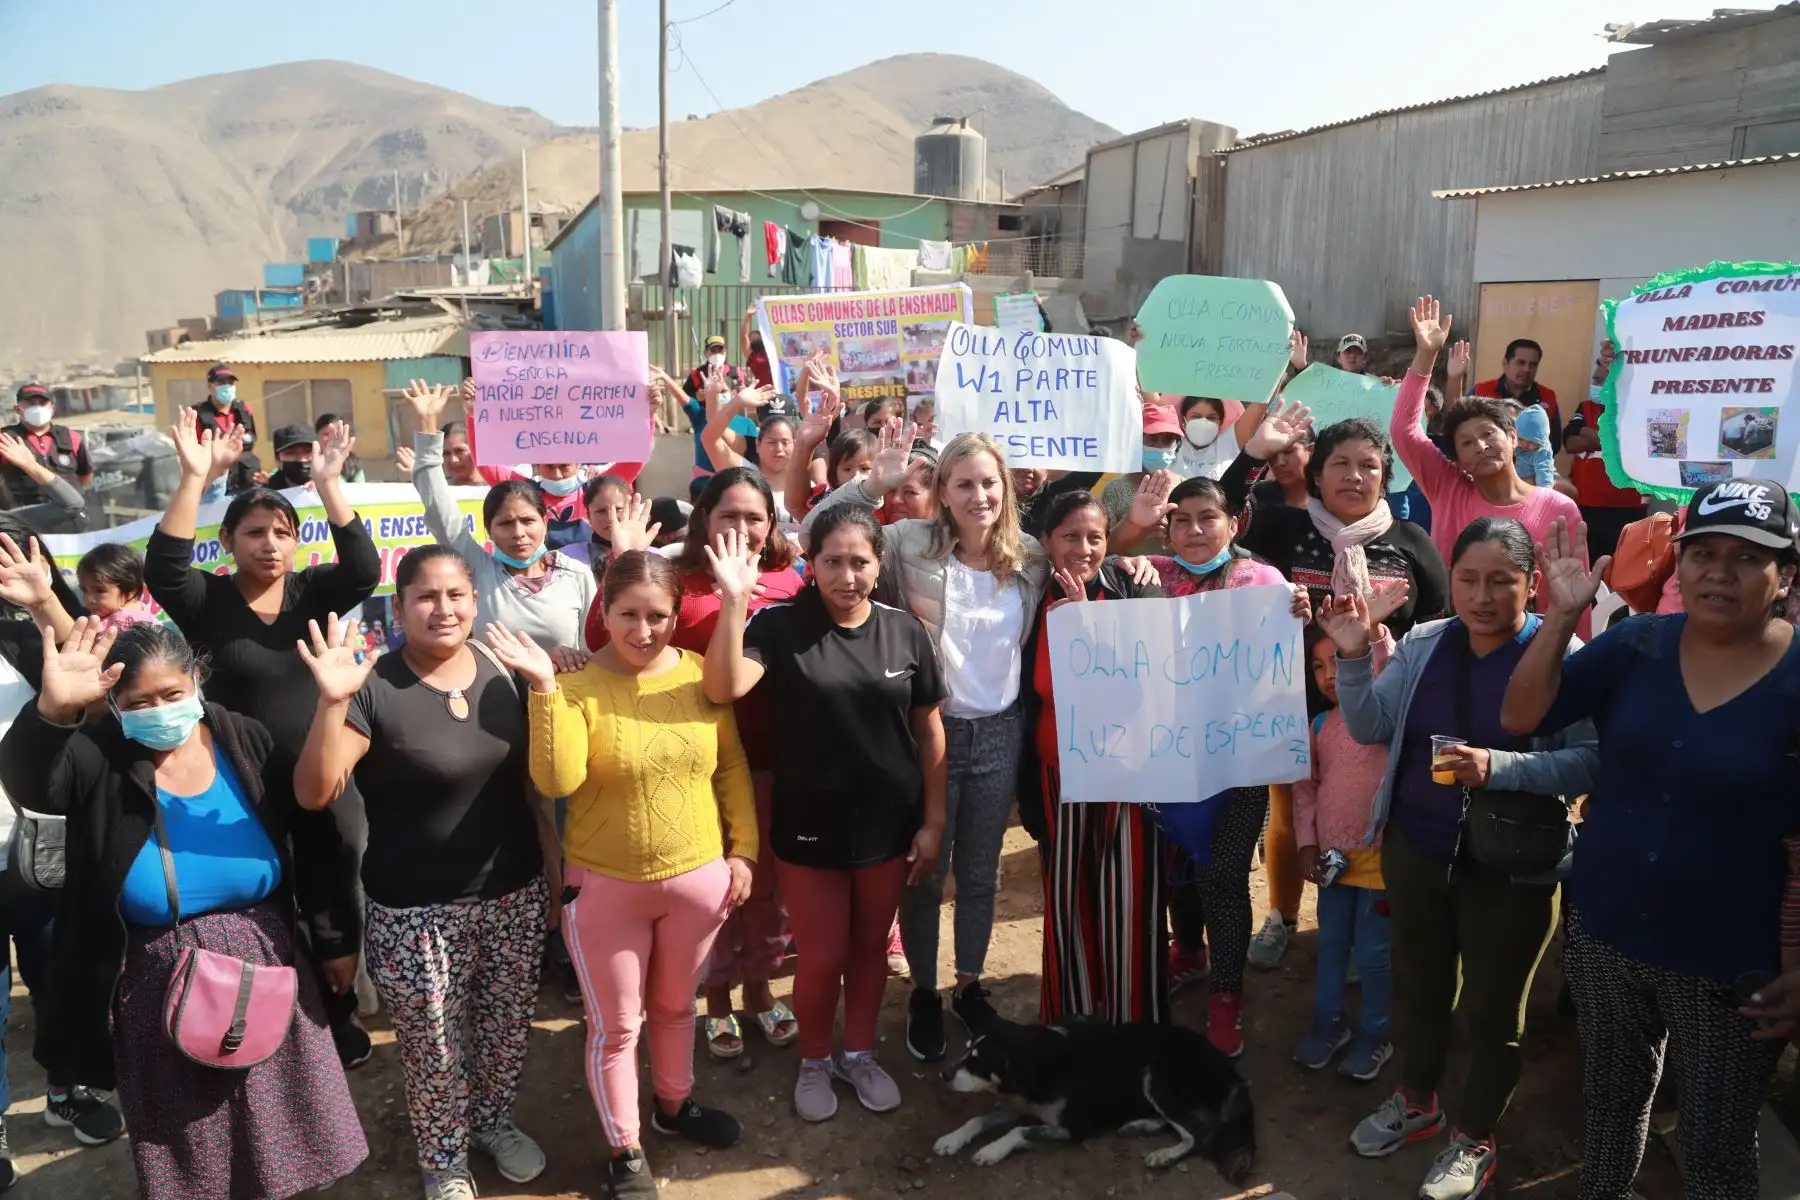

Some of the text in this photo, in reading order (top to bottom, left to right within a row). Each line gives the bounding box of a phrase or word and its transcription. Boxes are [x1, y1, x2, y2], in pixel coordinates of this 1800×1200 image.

[1635, 284, 1692, 303] OLLA
[771, 292, 958, 325] OLLAS COMUNES DE LA ENSENADA
[1168, 296, 1210, 321] OLLA
[834, 320, 898, 338] SECTOR SUR
[1662, 310, 1765, 332] MADRES
[951, 326, 1007, 356] OLLA
[1160, 331, 1290, 355] NUEVA FORTALEZ
[1621, 344, 1795, 365] RIUNFADORAS
[503, 366, 568, 382] SEÑORA
[1016, 368, 1097, 392] PARTE
[568, 384, 636, 400] CARMEN
[844, 384, 905, 399] RESENTE
[1650, 378, 1775, 395] PRESENTE
[478, 405, 624, 423] A NUESTRA ZONA
[993, 400, 1058, 423] ALTA
[515, 431, 599, 449] ENSENDA
[1708, 483, 1771, 501] NIKE
[1744, 502, 1771, 520] SB
[1069, 616, 1296, 686] OLLA COMÚN
[1068, 704, 1127, 763] LUZ
[1150, 724, 1191, 758] DE
